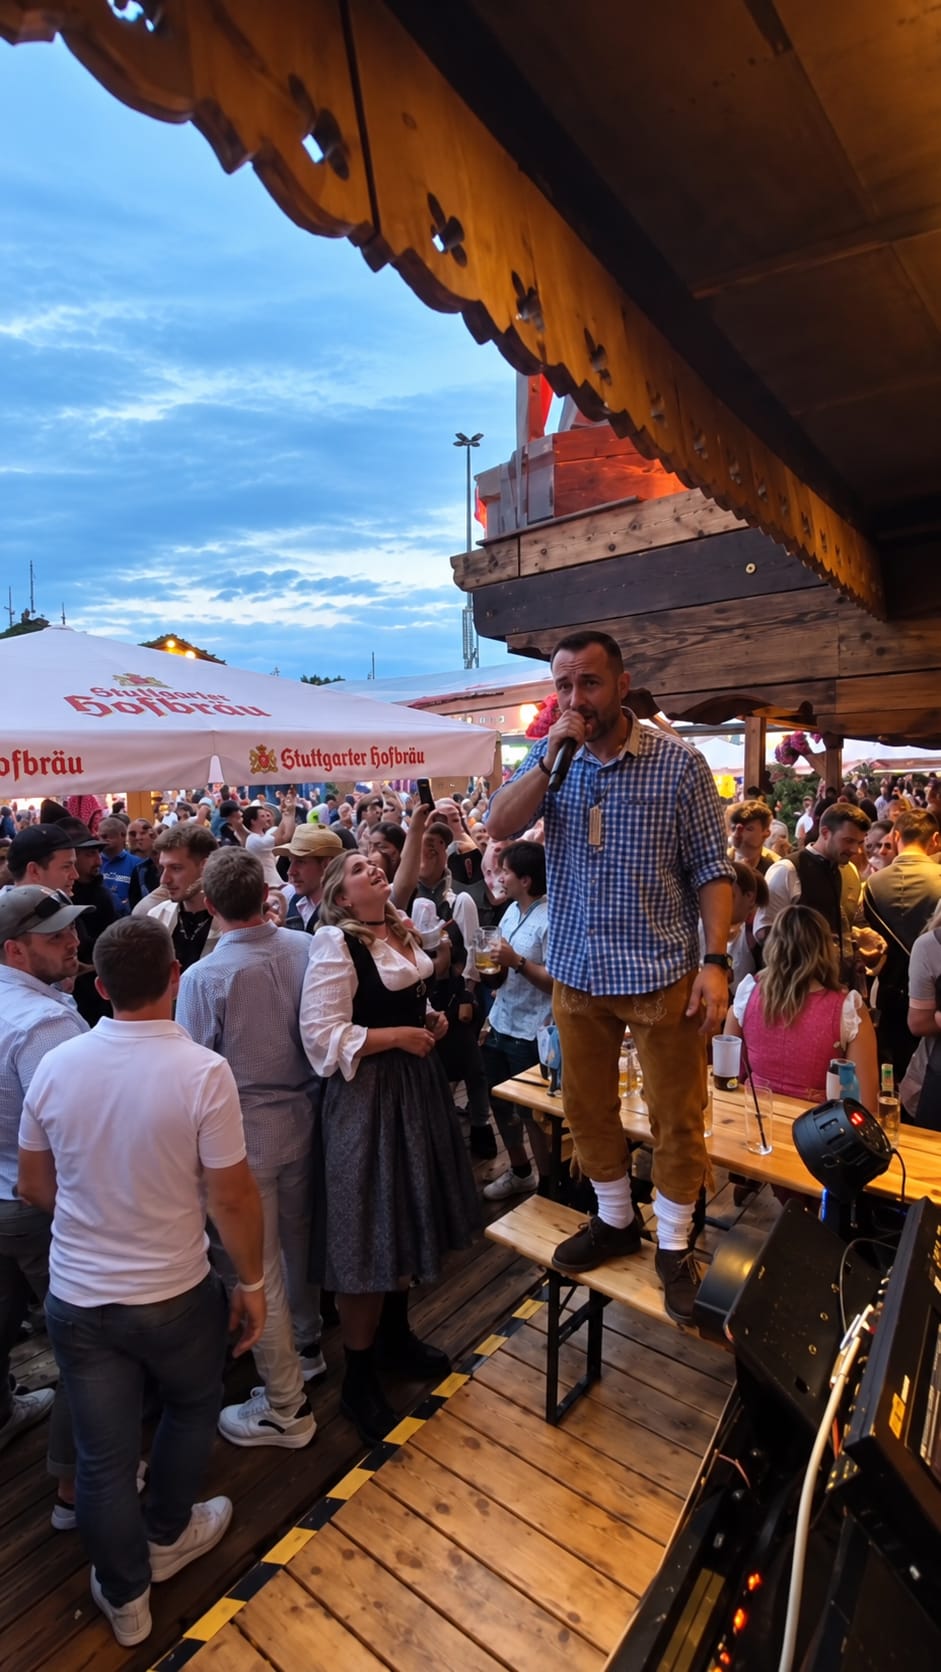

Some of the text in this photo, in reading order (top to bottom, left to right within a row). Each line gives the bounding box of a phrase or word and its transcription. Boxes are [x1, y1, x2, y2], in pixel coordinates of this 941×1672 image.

[64, 694, 273, 718] Hofbräu
[280, 745, 426, 773] Stuttgarter Hofbräu
